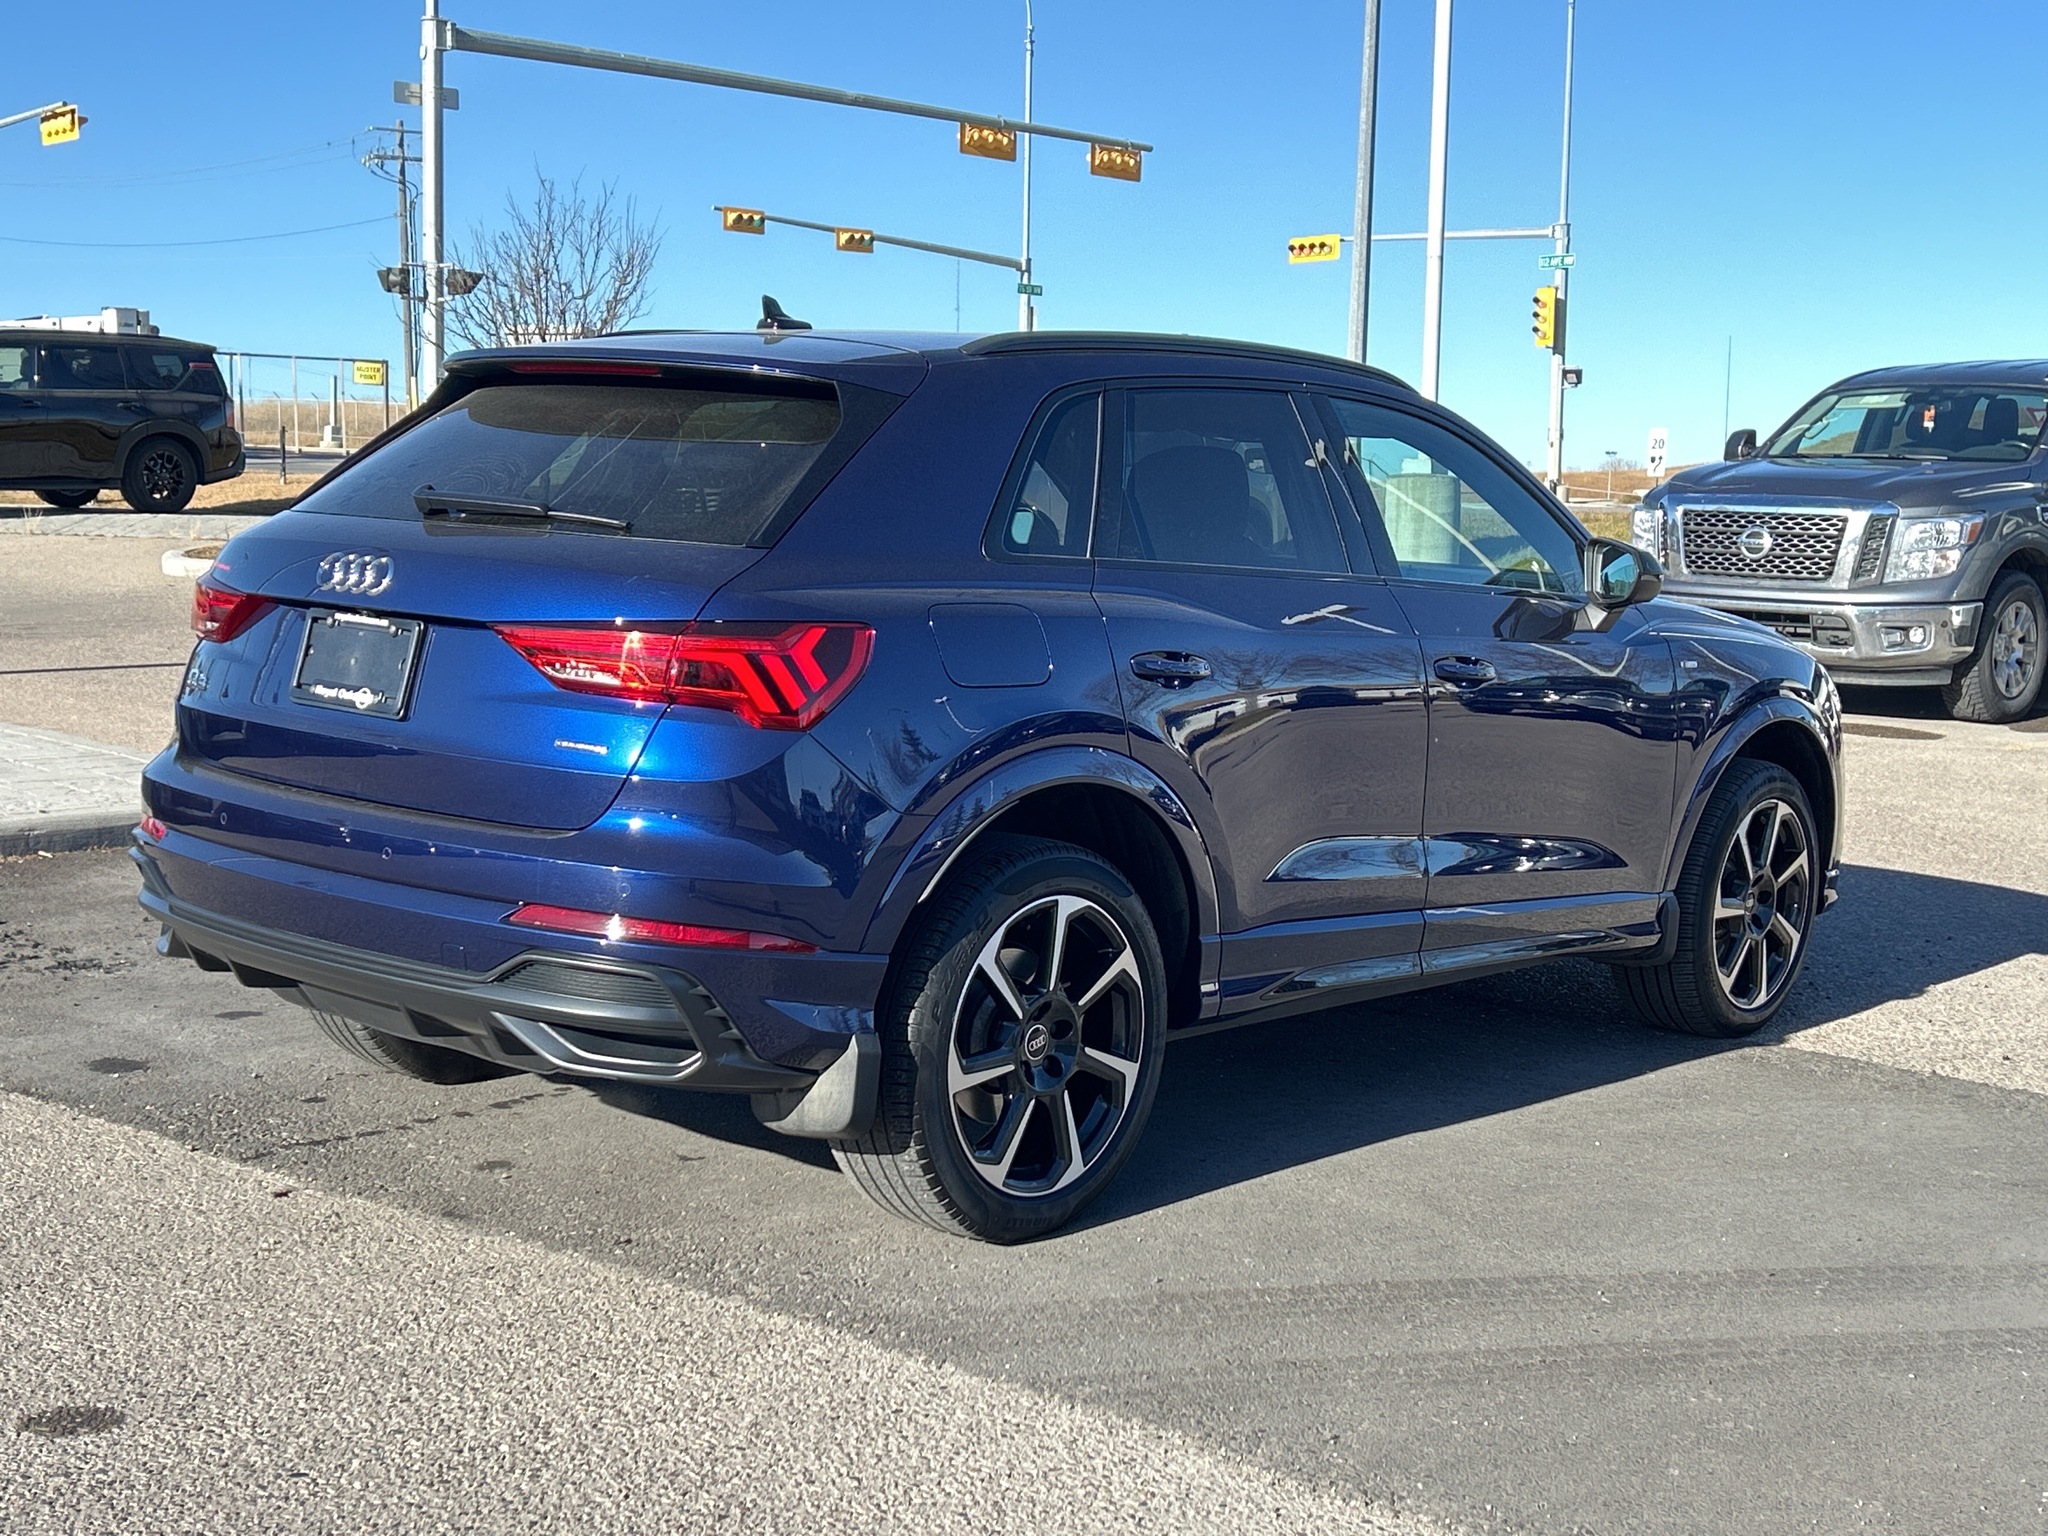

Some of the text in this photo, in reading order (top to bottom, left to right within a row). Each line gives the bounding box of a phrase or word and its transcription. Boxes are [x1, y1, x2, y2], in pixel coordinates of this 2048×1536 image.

[1550, 256, 1563, 266] AVE
[359, 373, 377, 381] POINT
[1651, 438, 1665, 450] 20
